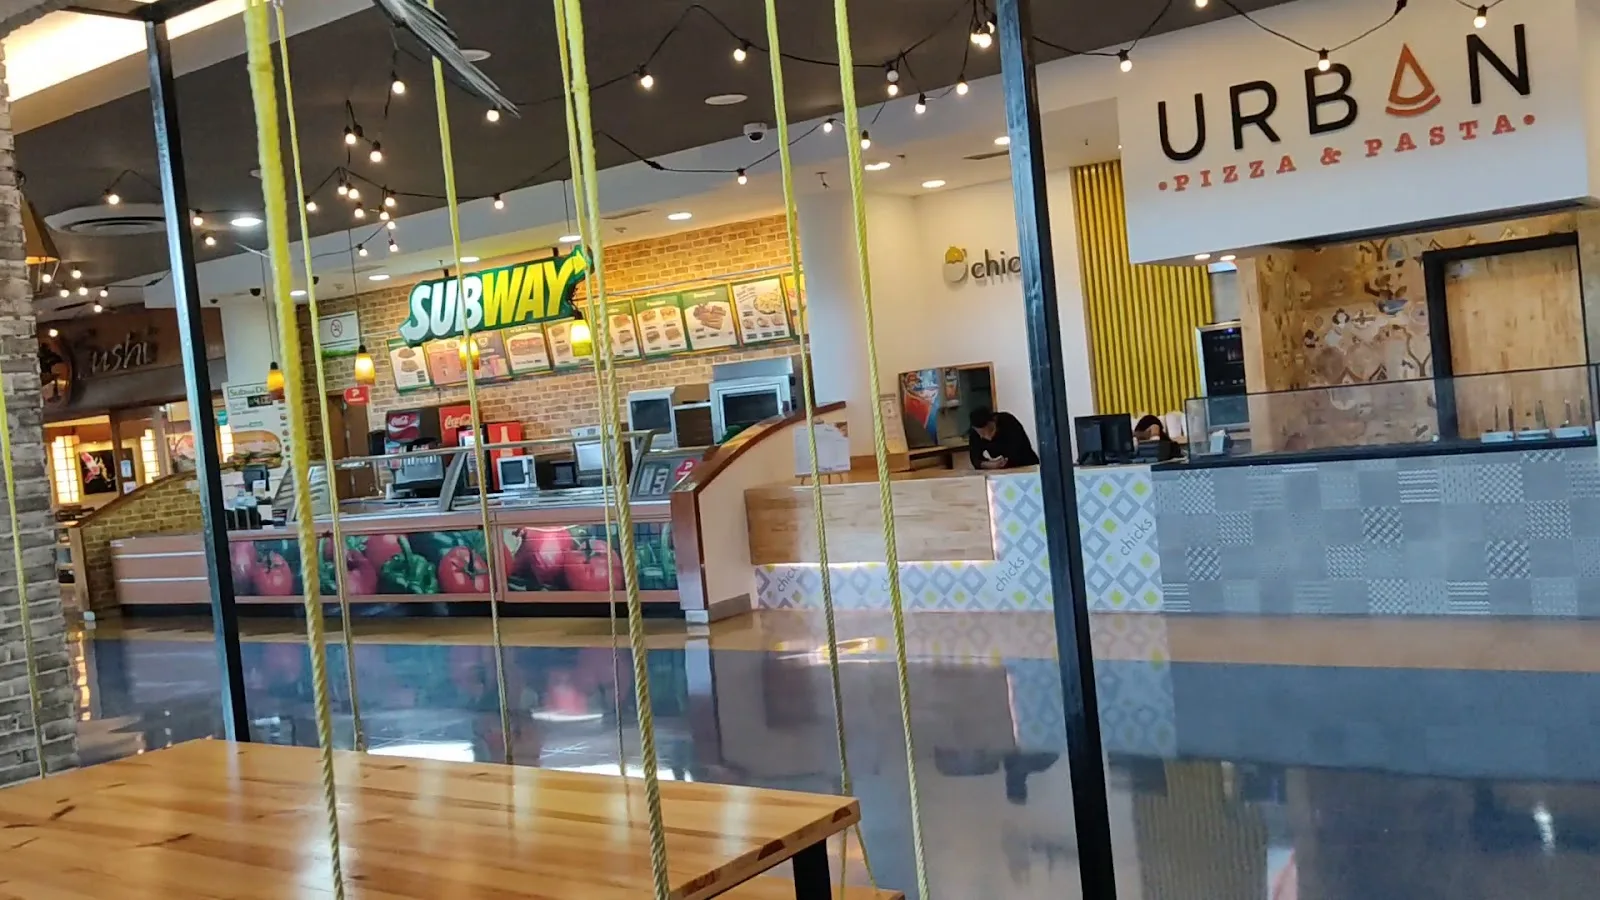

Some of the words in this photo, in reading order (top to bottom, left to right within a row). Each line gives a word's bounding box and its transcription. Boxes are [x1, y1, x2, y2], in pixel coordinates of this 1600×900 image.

[1158, 23, 1532, 162] URBAN
[1173, 154, 1297, 192] PIZZA
[1320, 146, 1342, 166] &
[1364, 113, 1516, 158] PASTA
[400, 248, 590, 344] SUBWAY
[994, 555, 1026, 593] chicks
[1119, 516, 1154, 557] chicks
